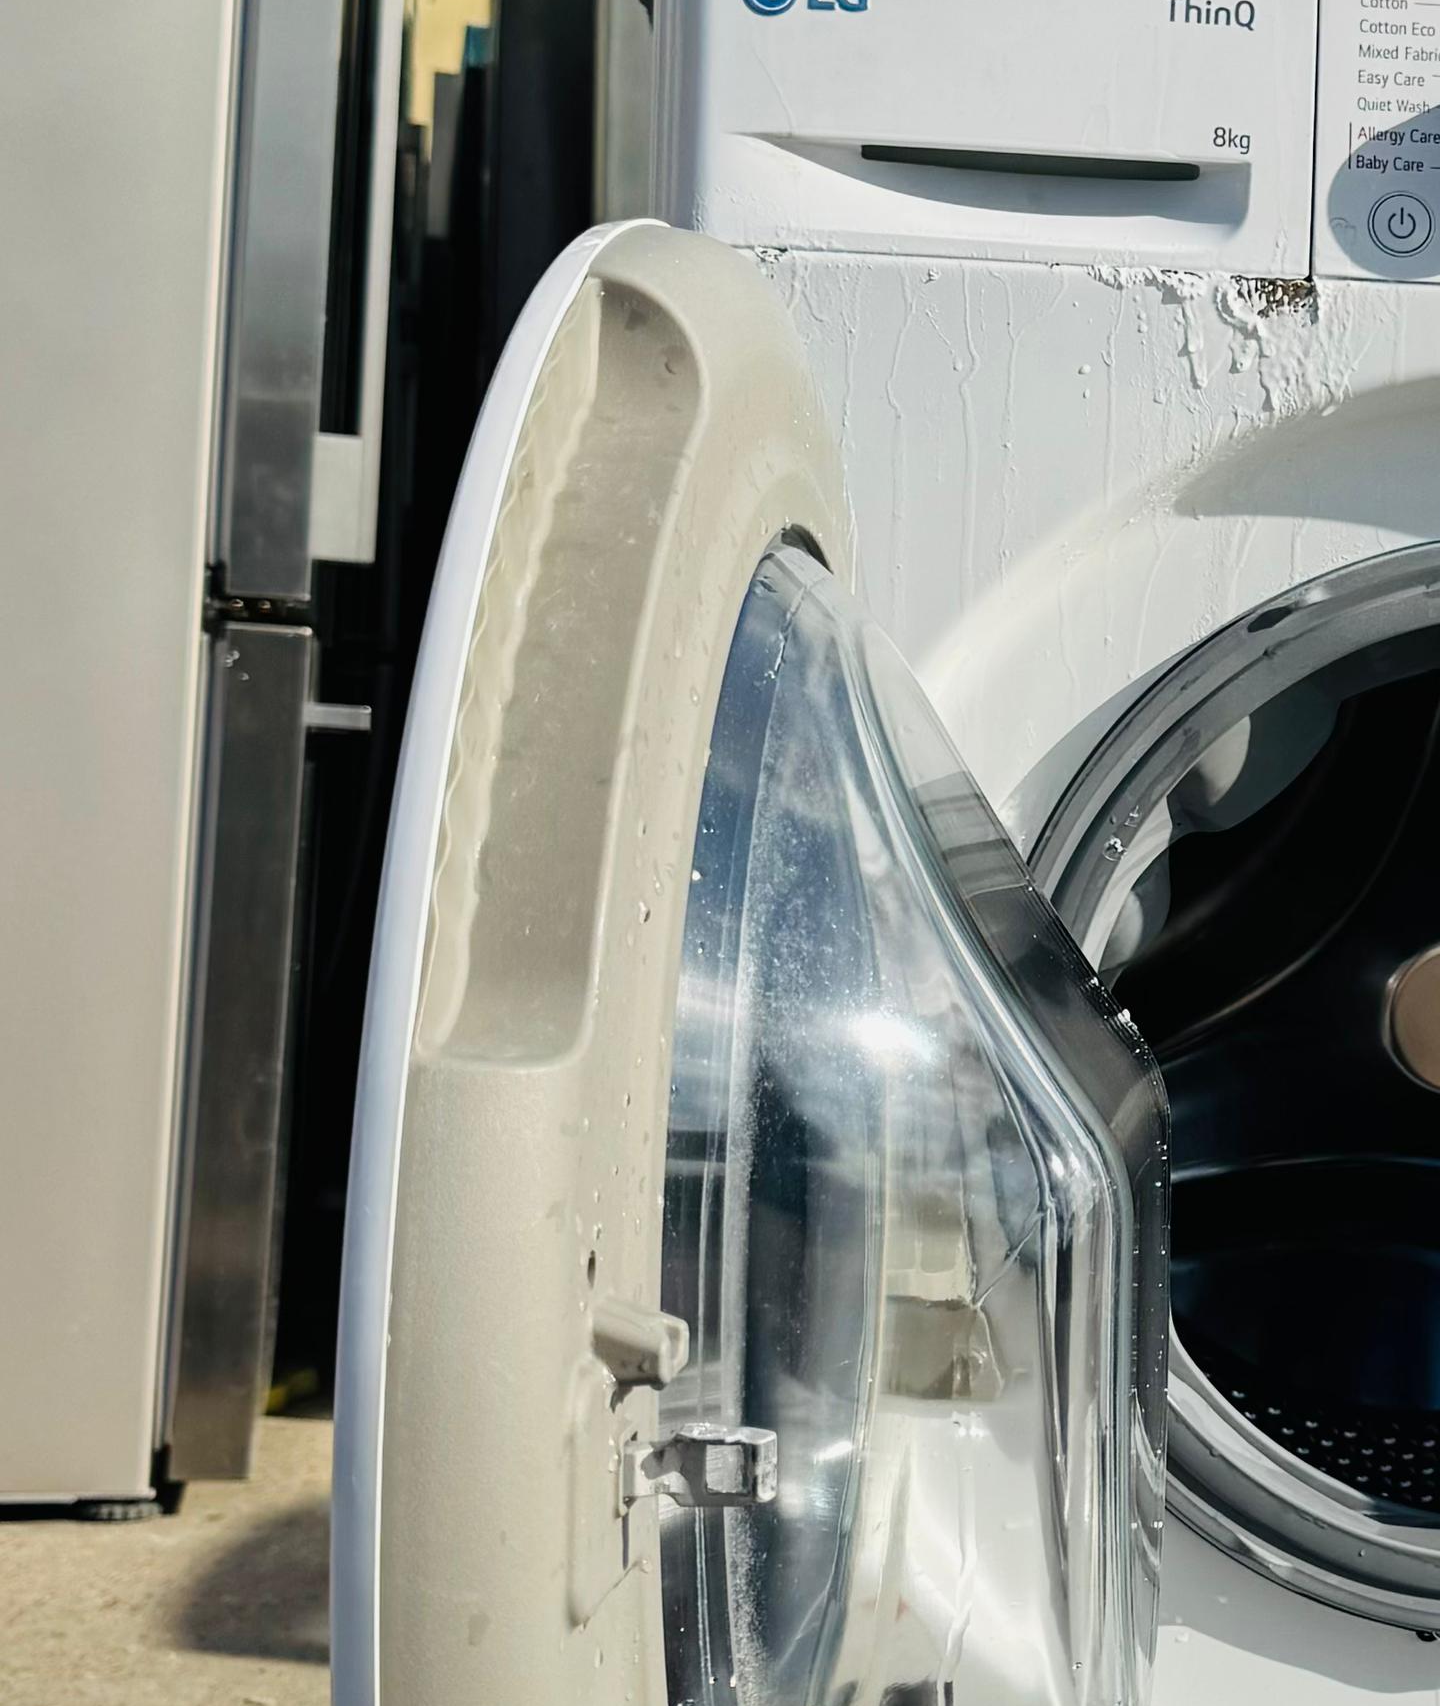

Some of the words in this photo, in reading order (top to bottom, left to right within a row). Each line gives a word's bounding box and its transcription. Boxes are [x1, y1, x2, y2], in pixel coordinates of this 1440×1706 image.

[1359, 19, 1407, 35] Cotton
[1412, 22, 1436, 36] Eco
[1358, 44, 1399, 60] Mixed
[1358, 69, 1389, 88] Easy
[1394, 72, 1425, 86] Care
[1357, 96, 1391, 112] Quiet
[1396, 99, 1430, 114] Wash
[1213, 127, 1250, 155] 8kg
[1358, 126, 1405, 146] Allergy
[1410, 129, 1440, 144] Care
[1356, 155, 1389, 174] Baby
[1393, 157, 1424, 172] Care
